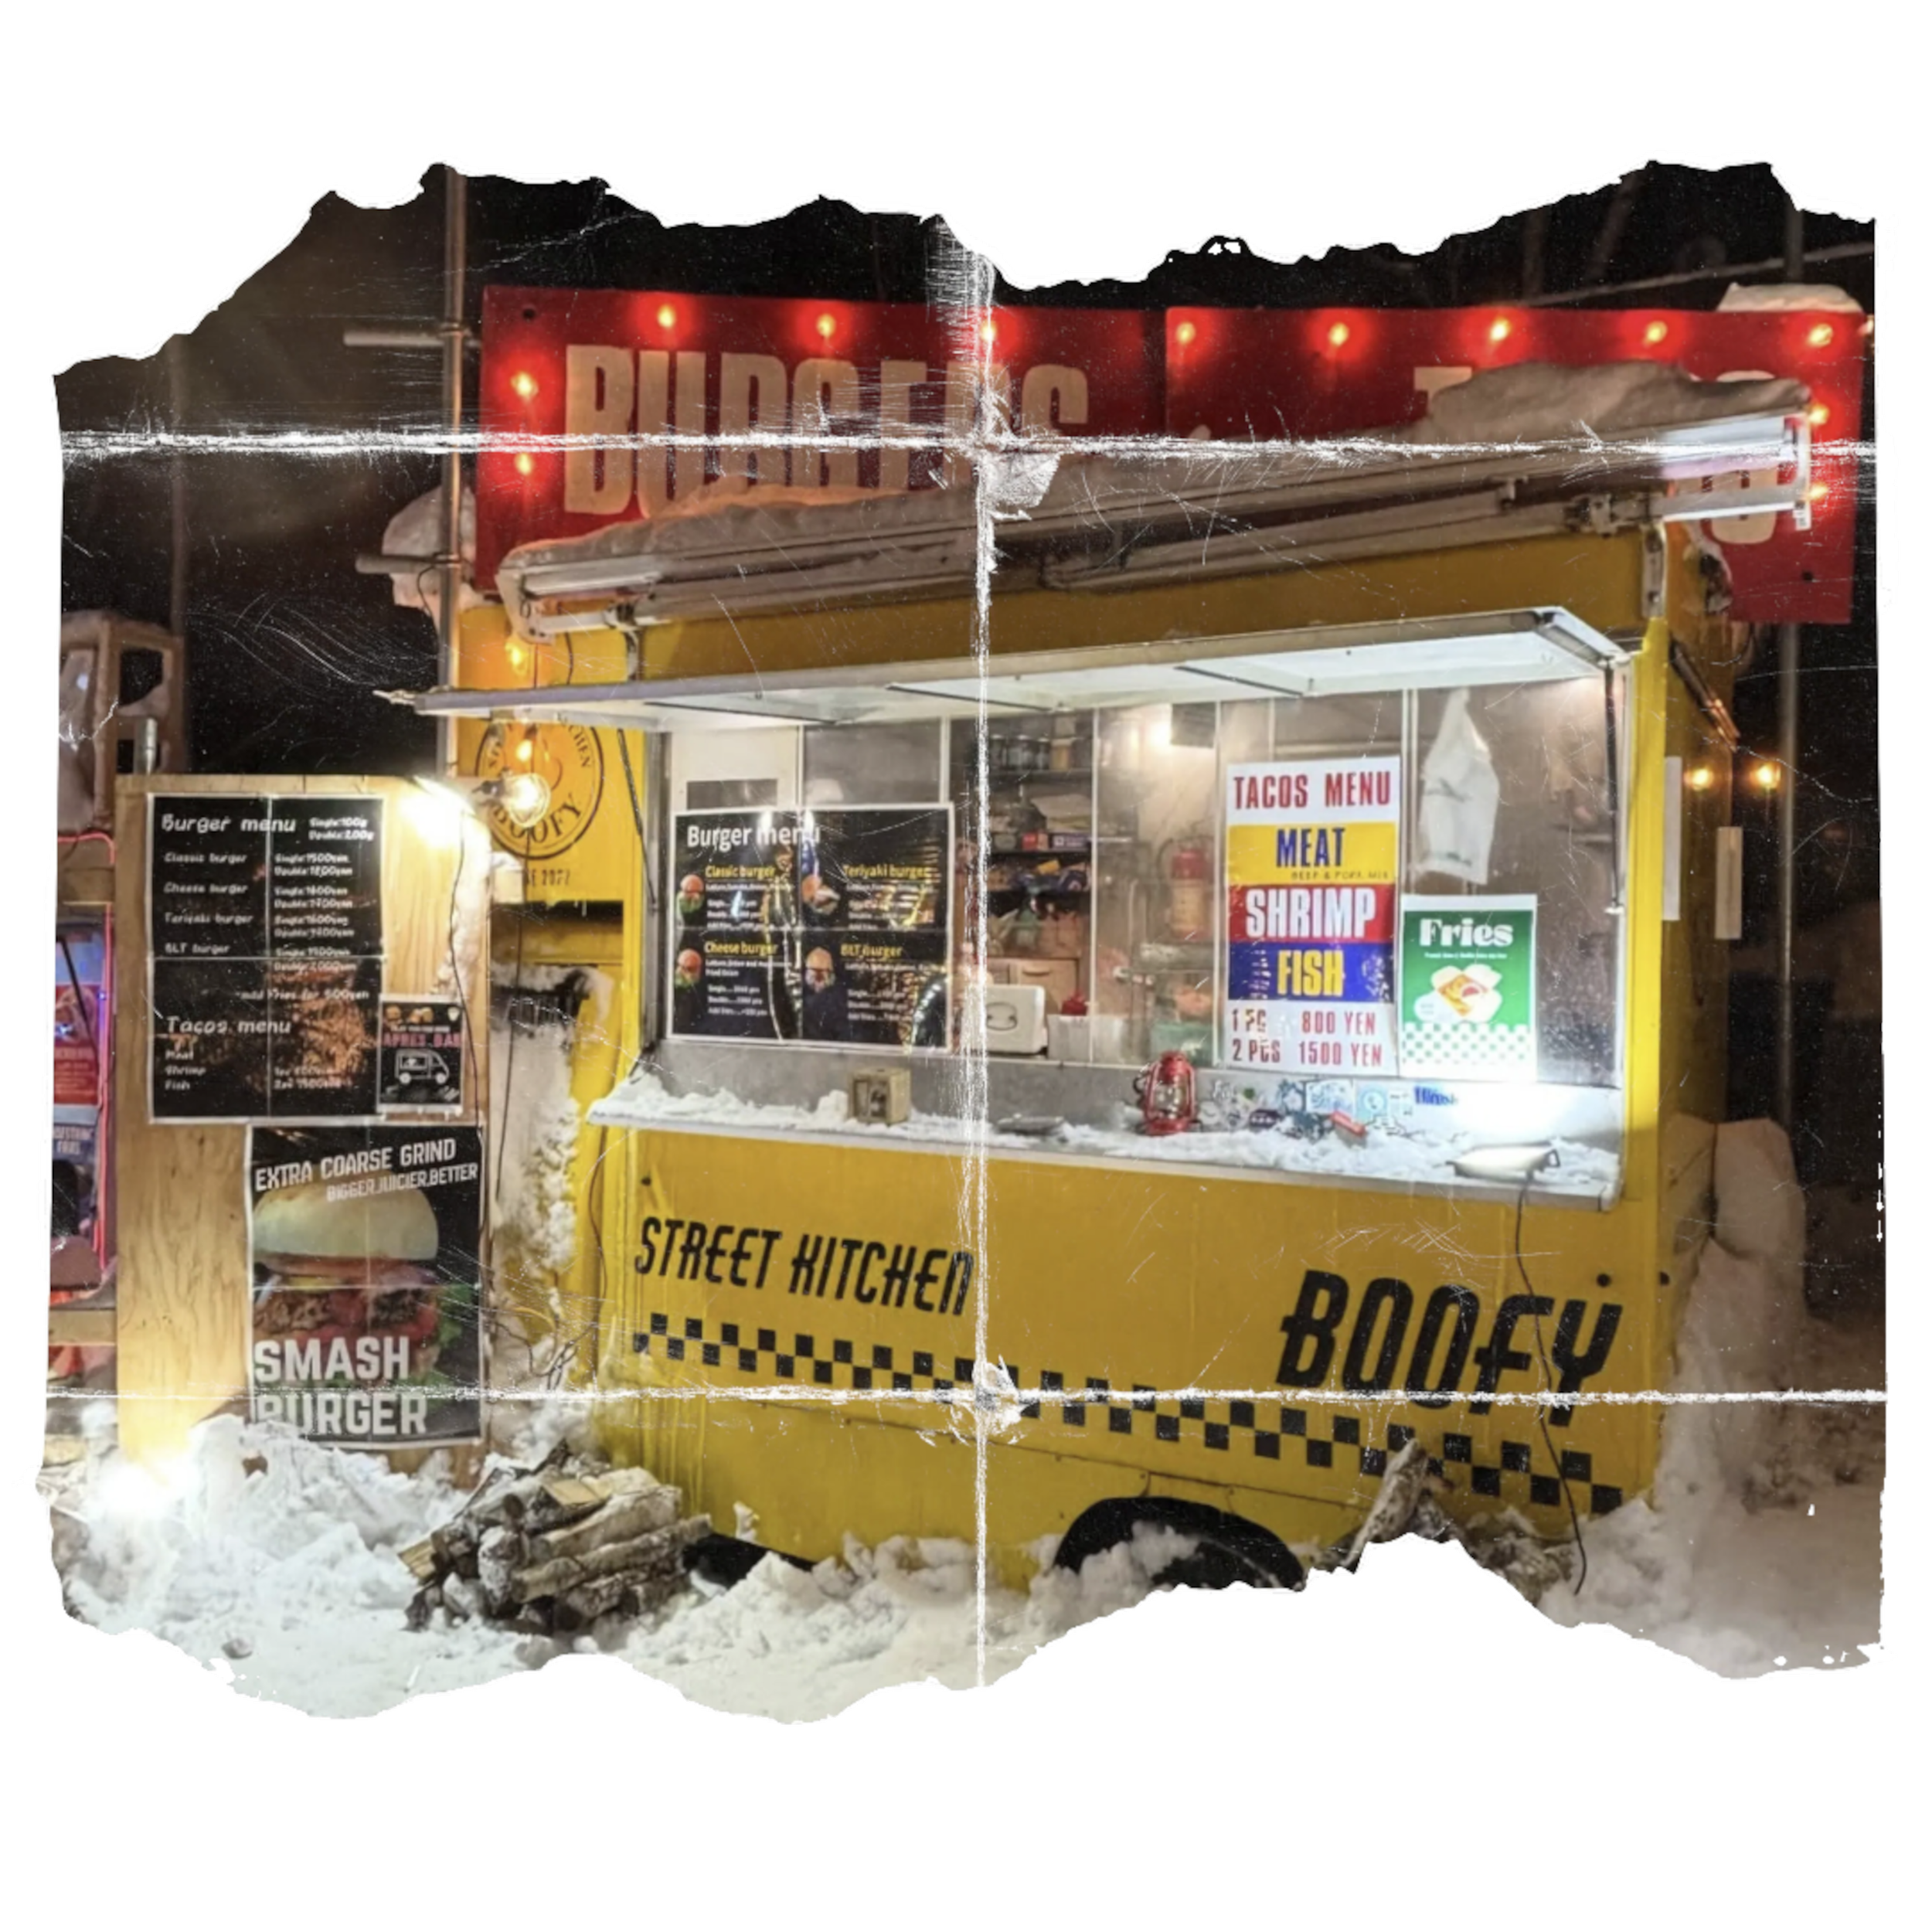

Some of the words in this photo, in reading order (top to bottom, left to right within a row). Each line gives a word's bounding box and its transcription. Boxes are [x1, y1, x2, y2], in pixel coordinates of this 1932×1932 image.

[1234, 774, 1308, 809] TACOS
[1325, 770, 1391, 808] MENU
[162, 814, 231, 834] Burger
[240, 818, 296, 832] menu
[687, 825, 751, 852] Burger
[757, 825, 821, 847] menu
[1276, 827, 1345, 868] MEAT
[164, 852, 205, 863] Classic
[209, 852, 247, 865] burger
[705, 865, 739, 879] Classic
[740, 865, 775, 880] burger
[842, 864, 888, 880] Teriyaki
[889, 864, 930, 880] burger
[1291, 870, 1315, 880] BEEF
[163, 882, 206, 894] Cheese
[209, 884, 248, 896] burger
[215, 913, 253, 926] burger
[1247, 888, 1376, 938] SHRIMP
[1420, 918, 1513, 948] Fries
[165, 943, 187, 954] BLT
[192, 944, 230, 955] burger
[704, 941, 740, 954] Cheese
[741, 941, 778, 957] burger
[862, 945, 903, 959] burger
[1277, 950, 1344, 997] FISH
[167, 1015, 227, 1035] Tacos
[238, 1020, 291, 1034] menu
[1232, 1009, 1239, 1032] 1
[1246, 1009, 1266, 1032] PC
[1301, 1010, 1336, 1034] 800
[1345, 1012, 1376, 1036] YEN
[165, 1050, 194, 1060] Meat
[1233, 1039, 1243, 1061] 2
[1248, 1040, 1281, 1064] PCS
[1298, 1041, 1342, 1066] 1500
[1351, 1043, 1382, 1067] YEN
[165, 1065, 206, 1077] Shrimp
[165, 1080, 191, 1090] Fish
[255, 1161, 312, 1192] EXTRA
[321, 1147, 393, 1181] COARSE
[400, 1138, 456, 1168] GRIND
[635, 1216, 782, 1290] STREET
[788, 1234, 974, 1316] KITCHEN
[1276, 1270, 1623, 1427] BOOFY
[254, 1336, 410, 1383] SMASH
[254, 1391, 427, 1435] BURGER
